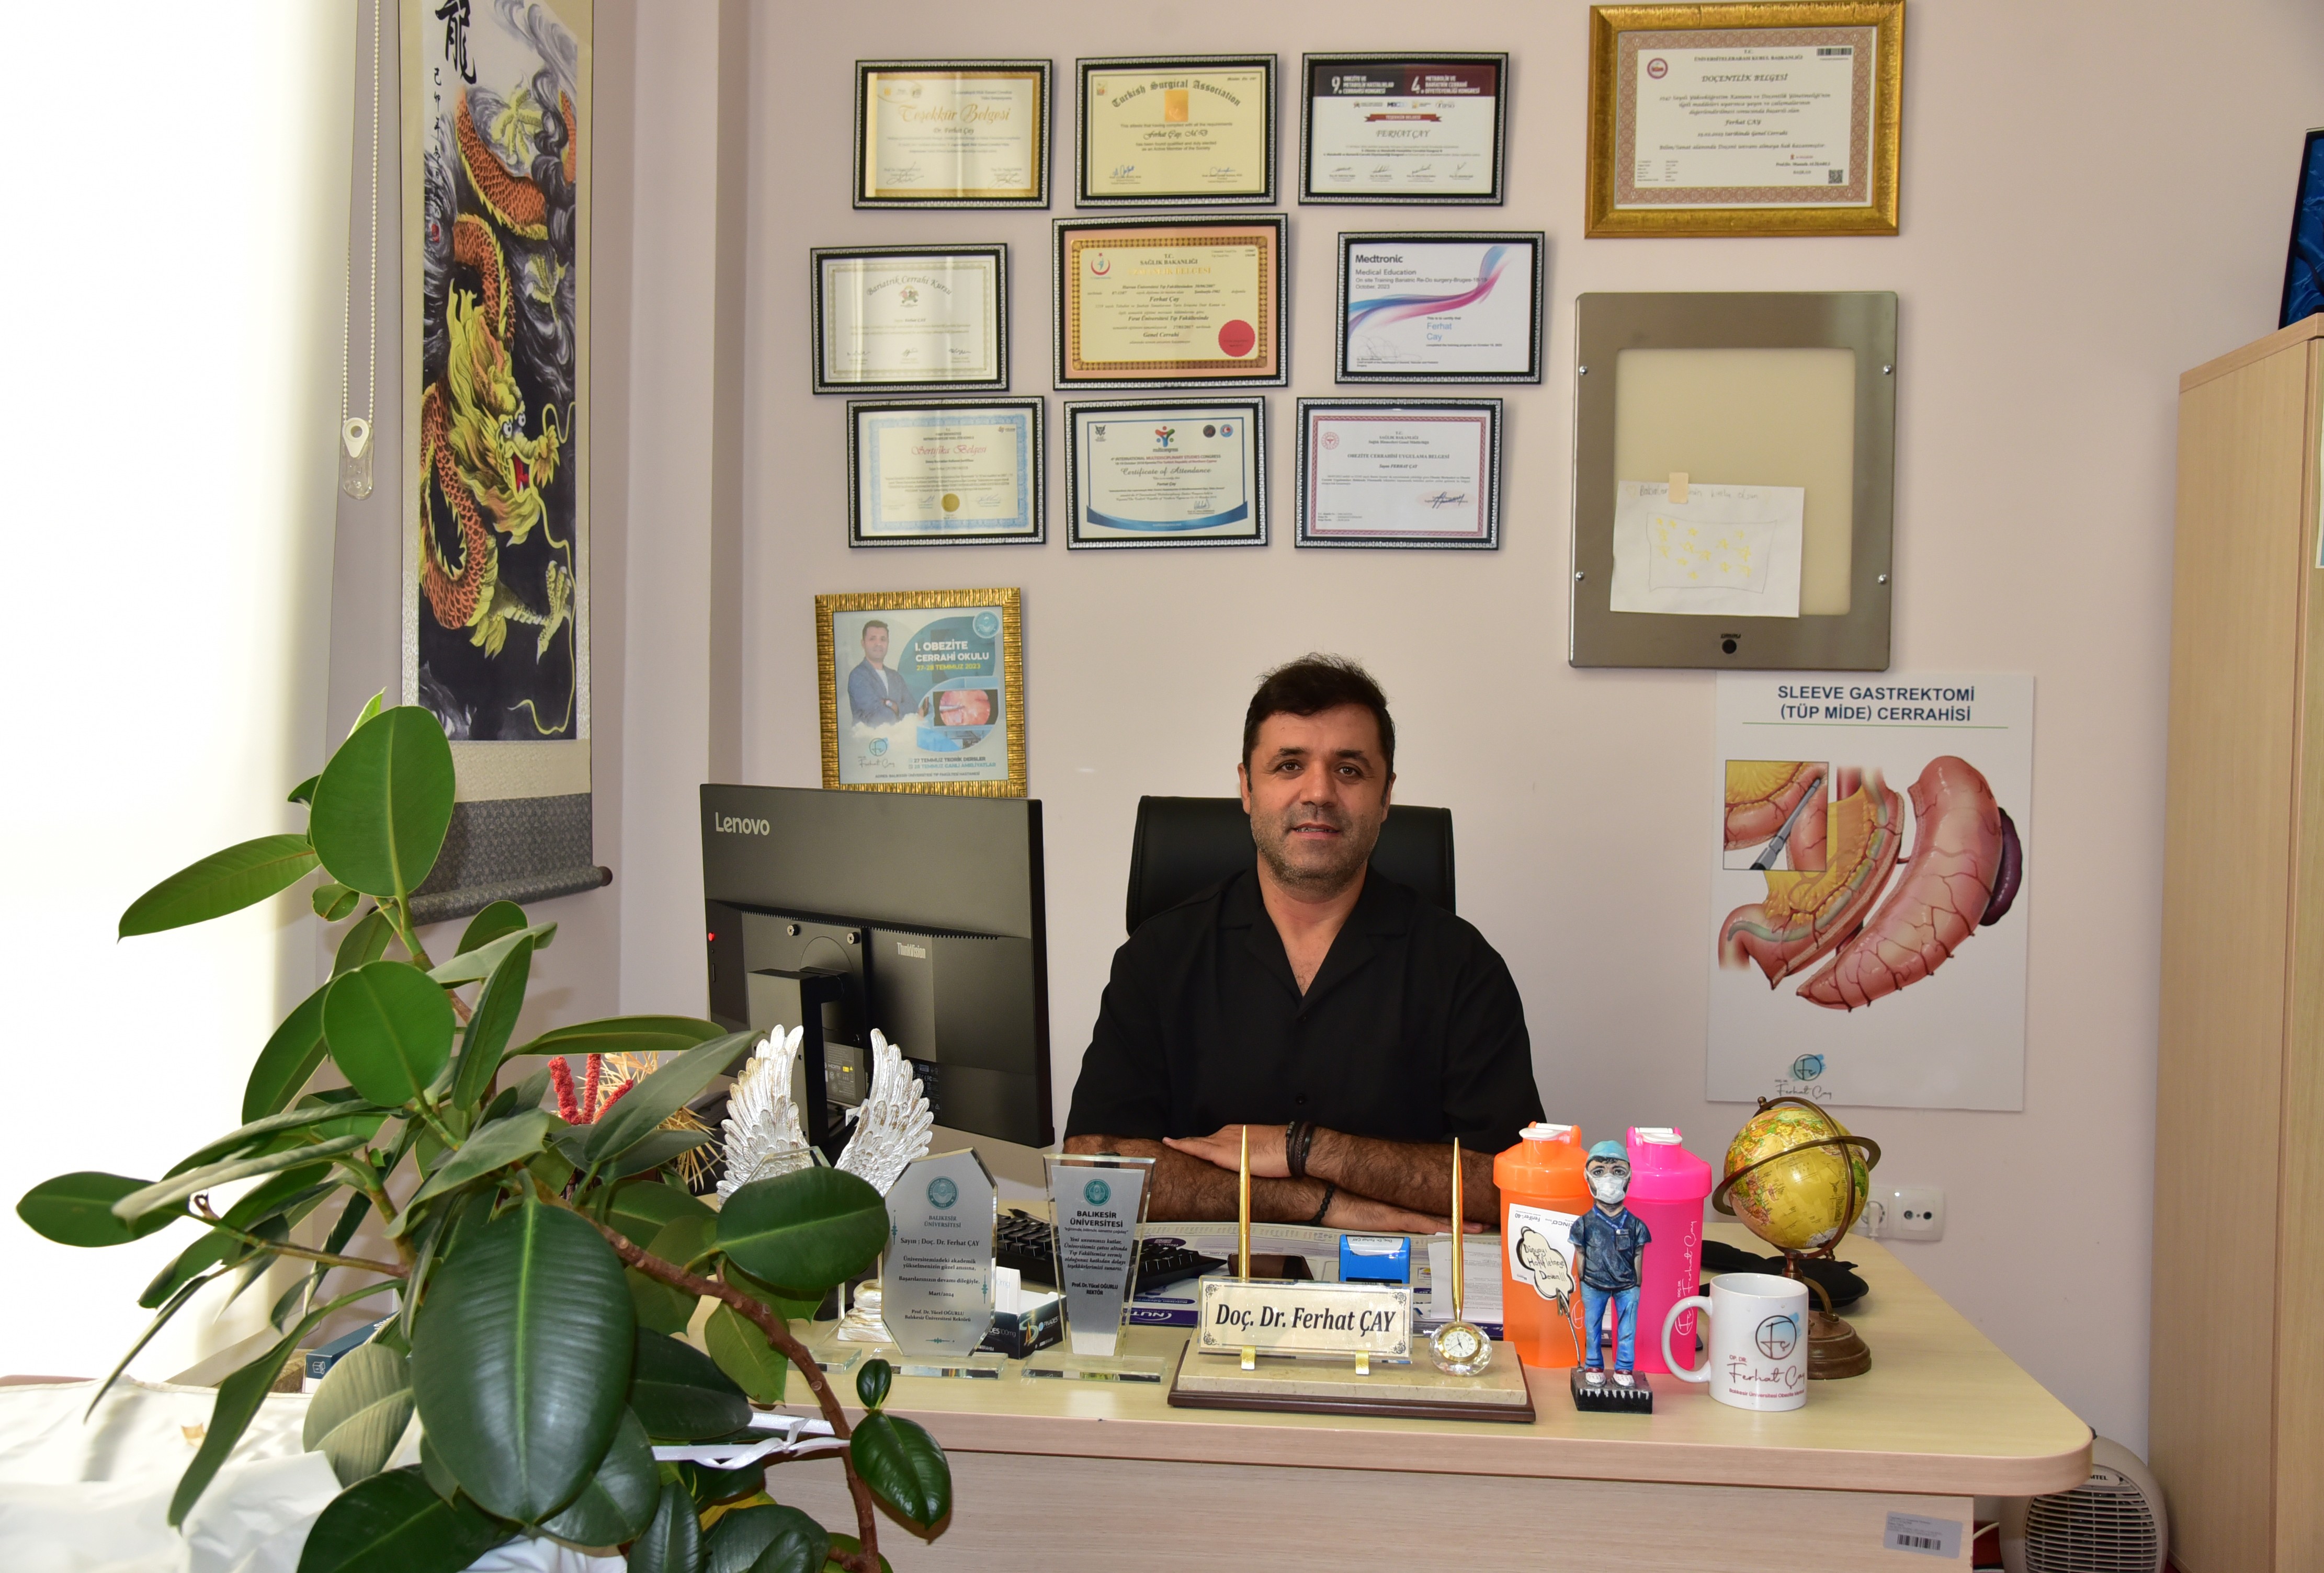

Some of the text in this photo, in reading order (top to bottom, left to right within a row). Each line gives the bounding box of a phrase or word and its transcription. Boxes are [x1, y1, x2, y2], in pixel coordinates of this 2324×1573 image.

[1702, 73, 1788, 83] DOÇENTLİK BELGESİ
[1112, 80, 1241, 107] Turkish Surgical Association
[898, 104, 1011, 124] Teşekkür Belgesi
[1413, 130, 1431, 139] ÇAY
[1355, 254, 1403, 264] Medtronic
[900, 276, 929, 286] Cerrahi
[929, 278, 952, 296] Kursu
[1426, 333, 1442, 341] Cay
[911, 444, 987, 458] Sertifika Belgesi
[1120, 467, 1158, 477] Certificate
[1160, 467, 1168, 476] of
[923, 638, 968, 651] OBEZİTE
[915, 652, 990, 662] CERRAHİ OKULU
[1778, 686, 1975, 702] SLEEVE GASTREKTOMİ
[1780, 703, 1971, 722] (TÜP MİDE) CERRAHİSİ
[715, 812, 770, 837] Lenovo
[897, 942, 926, 959] ThinkVision
[1775, 1084, 1809, 1097] Ferhat
[1076, 1210, 1117, 1218] BALIKESİR
[1070, 1217, 1123, 1228] ÜNİVERSİTESİ
[1682, 1248, 1694, 1296] Ferhat
[1215, 1303, 1396, 1337] Doç. Dr. Ferhat ÇAY
[1726, 1362, 1805, 1389] Ferhat Çay
